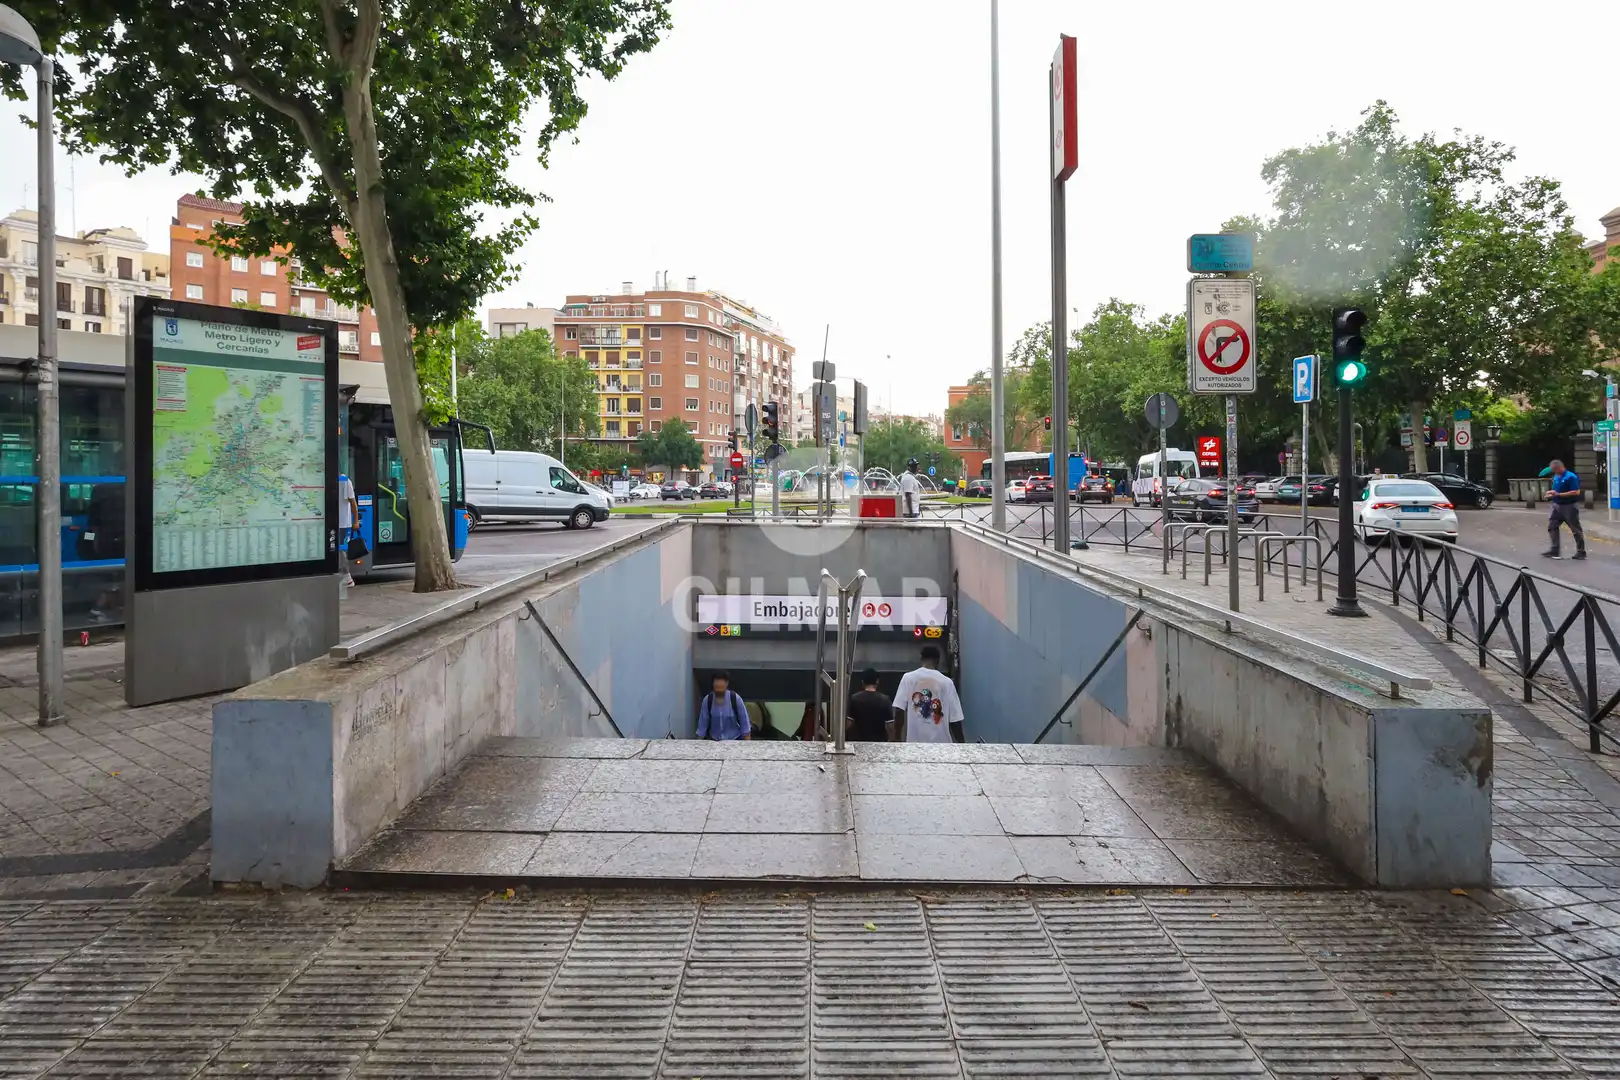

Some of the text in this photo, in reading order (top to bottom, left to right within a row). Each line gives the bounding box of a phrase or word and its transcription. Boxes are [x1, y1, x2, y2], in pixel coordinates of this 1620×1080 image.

[235, 324, 249, 334] de
[204, 331, 281, 347] Metro Ligero y
[216, 342, 270, 354] Cercanías
[1297, 363, 1309, 397] P
